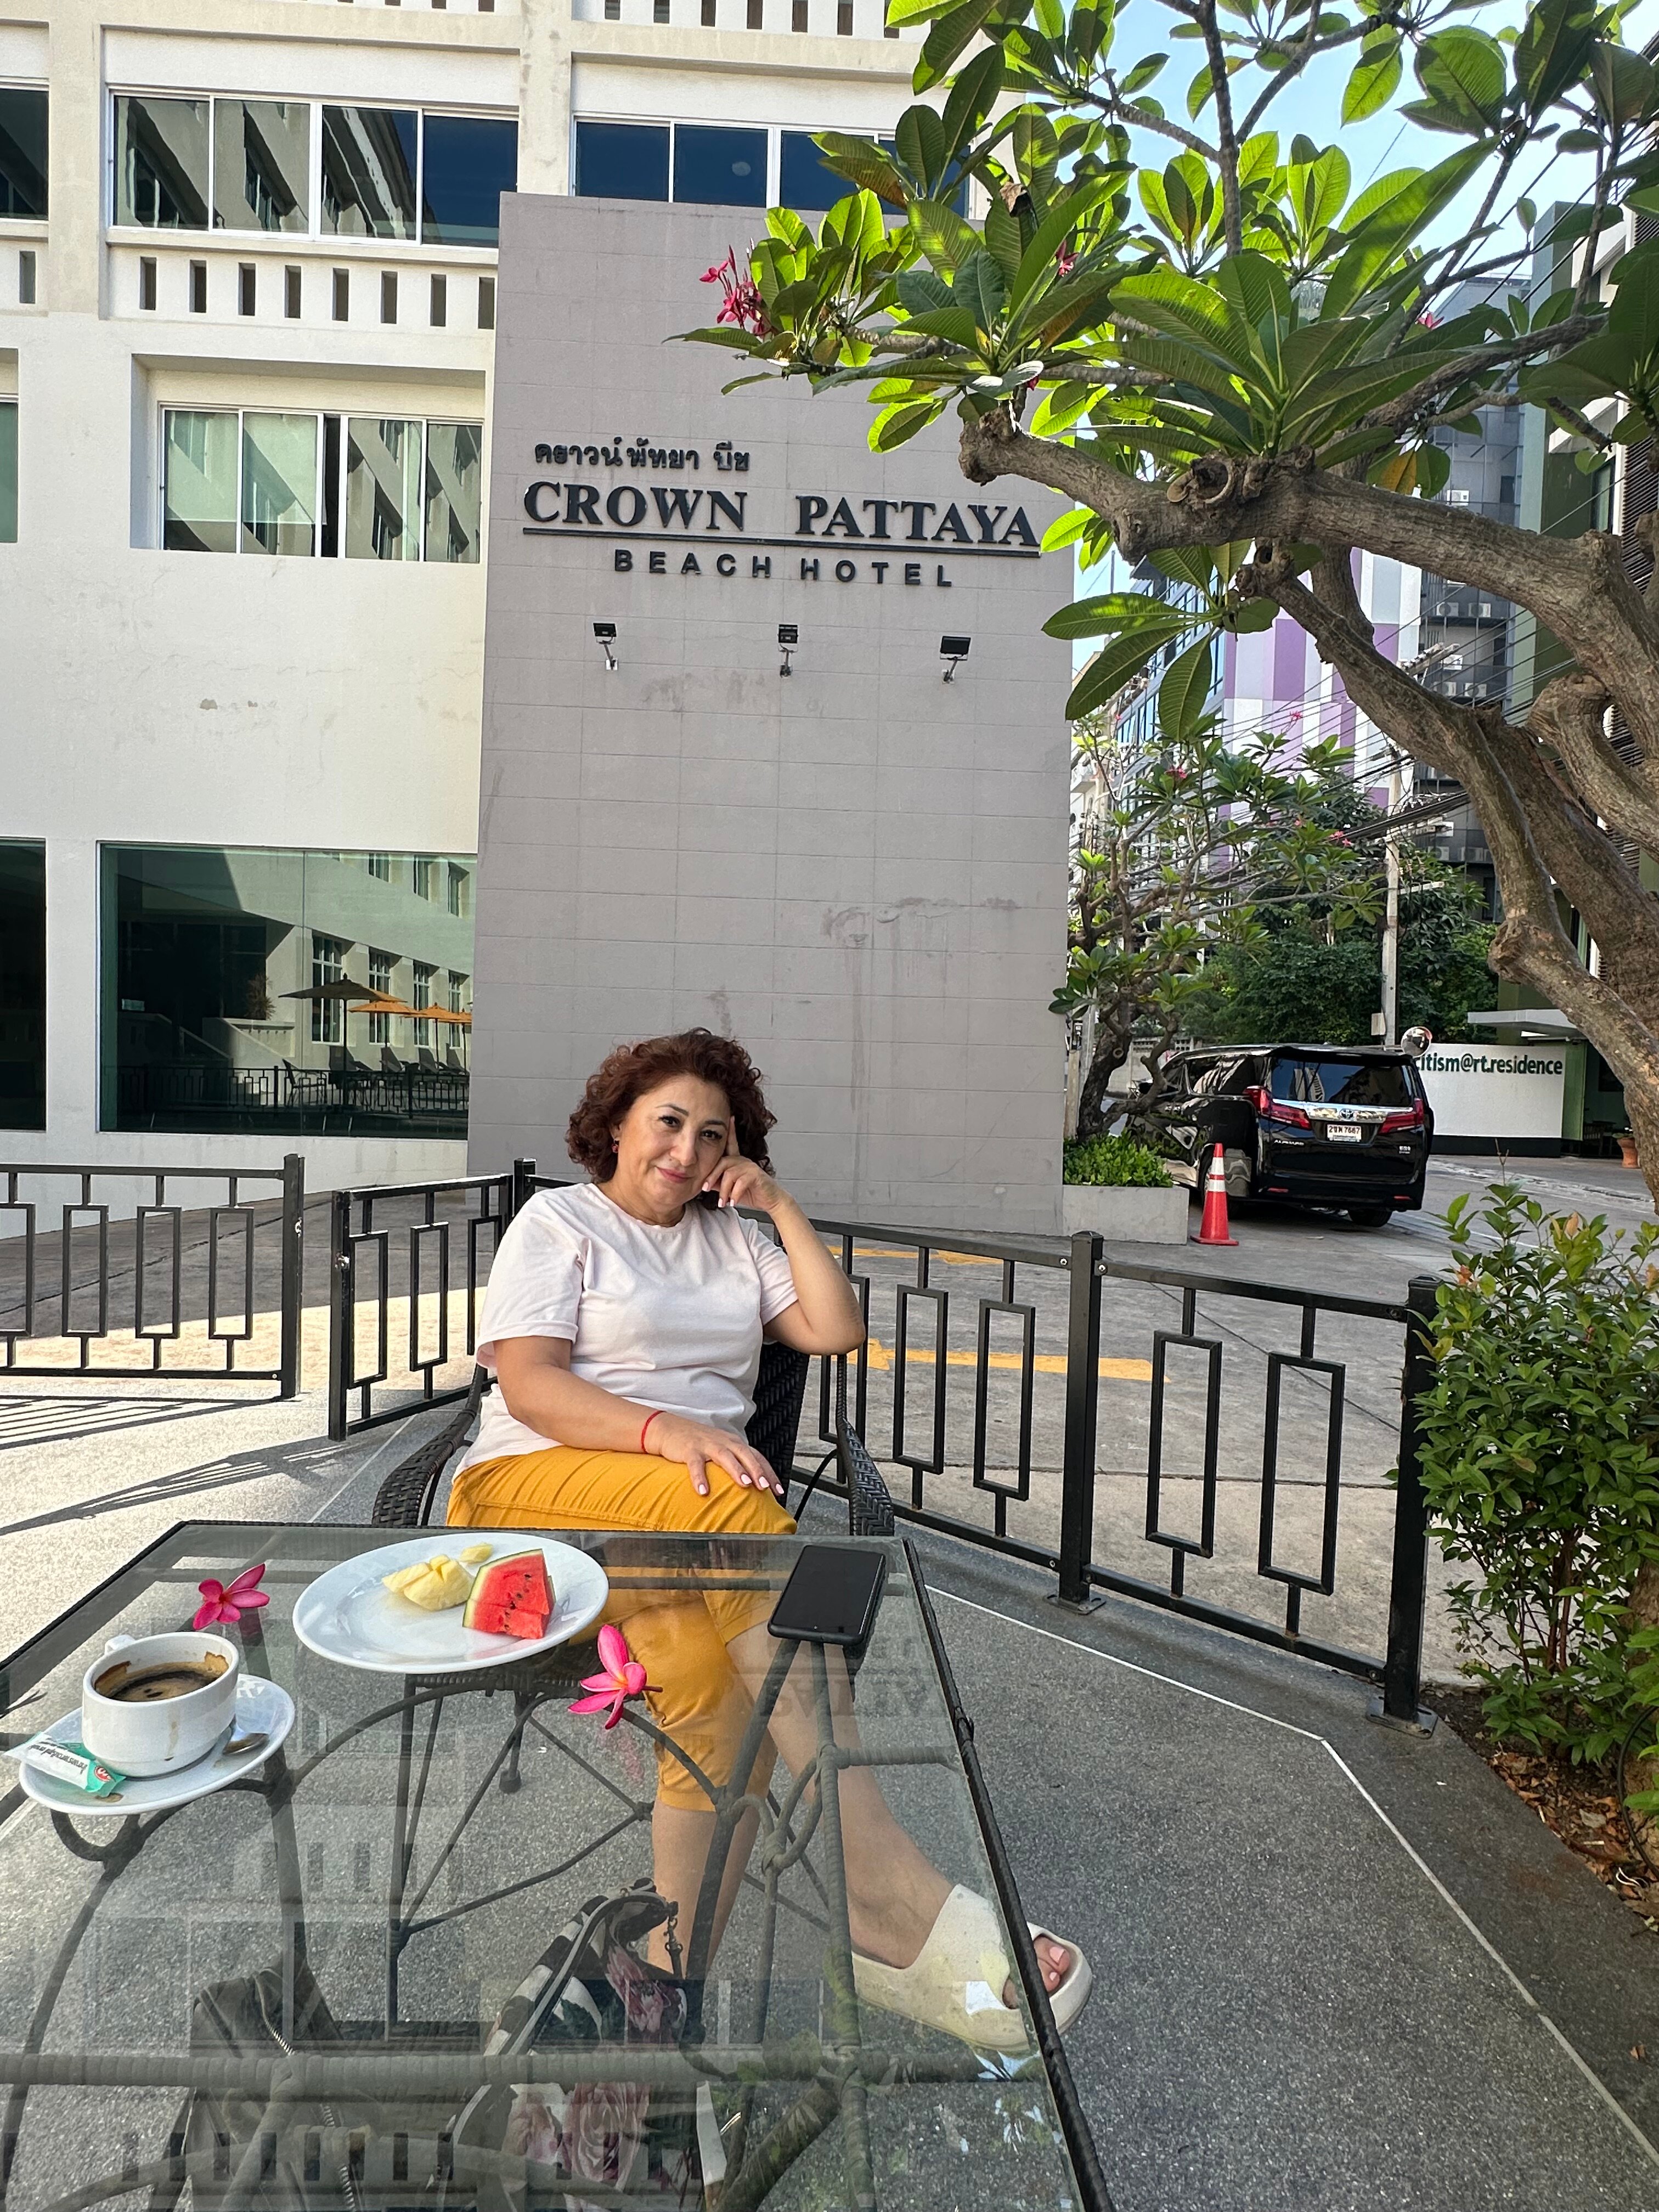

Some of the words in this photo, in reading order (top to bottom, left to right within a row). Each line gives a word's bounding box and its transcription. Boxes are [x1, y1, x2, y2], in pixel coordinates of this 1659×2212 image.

[523, 481, 747, 531] CROWN
[795, 495, 1040, 546] PATTAYA
[615, 550, 771, 579] BEACH
[800, 557, 952, 588] HOTEL
